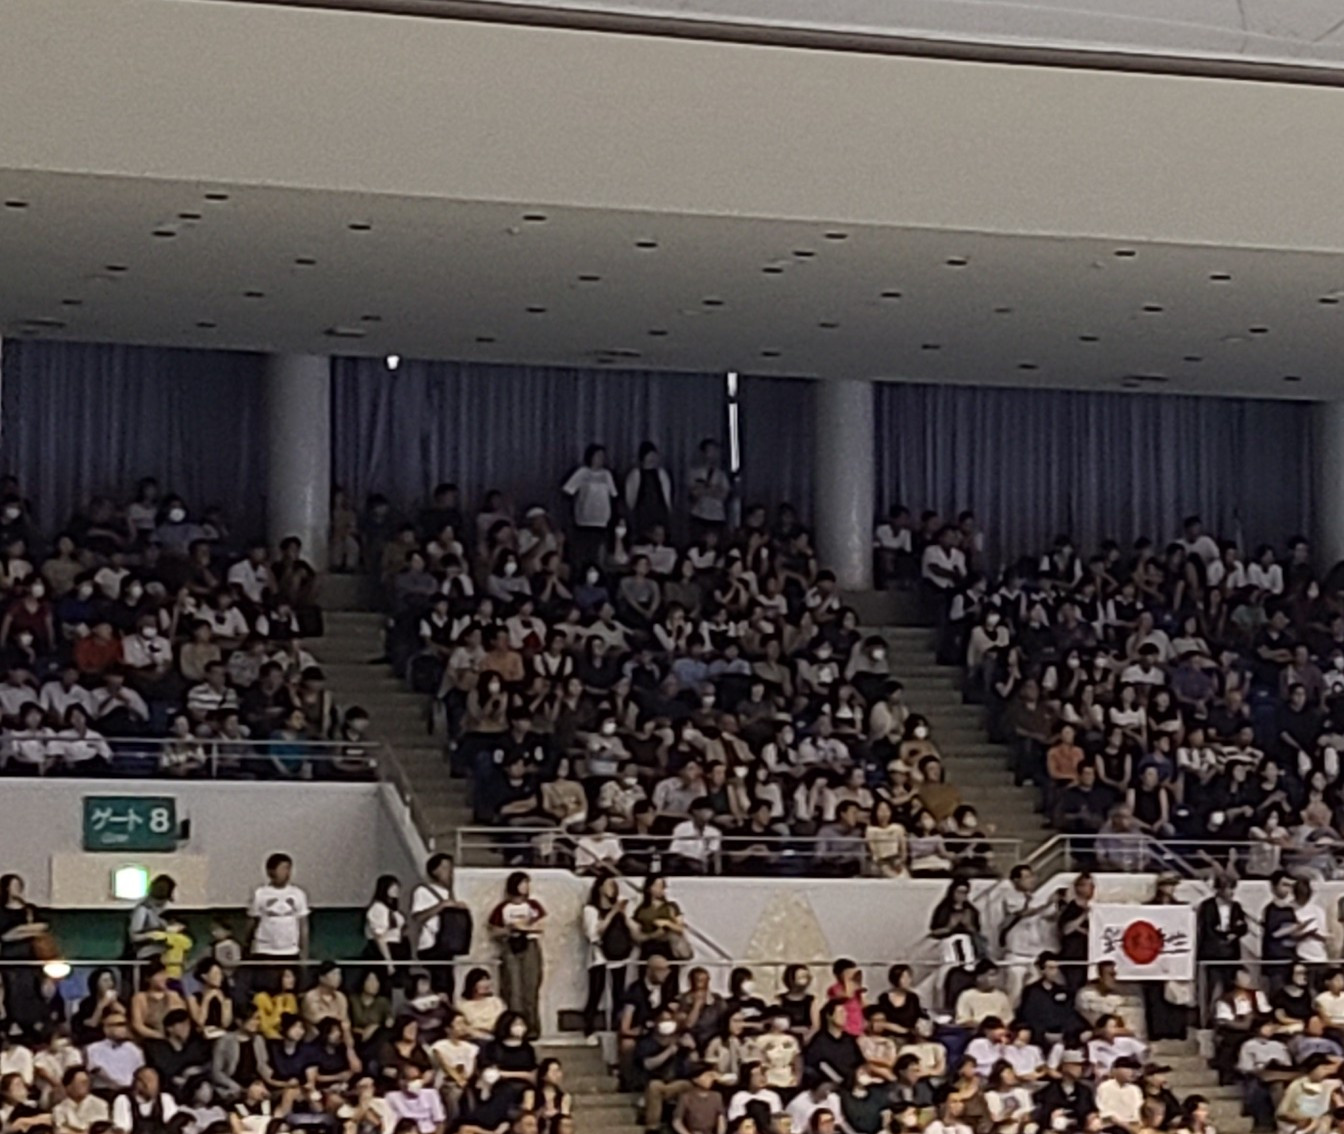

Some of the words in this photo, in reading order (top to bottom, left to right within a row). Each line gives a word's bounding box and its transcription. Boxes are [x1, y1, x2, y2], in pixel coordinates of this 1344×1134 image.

[91, 806, 144, 831] ゲート
[149, 806, 170, 833] 8
